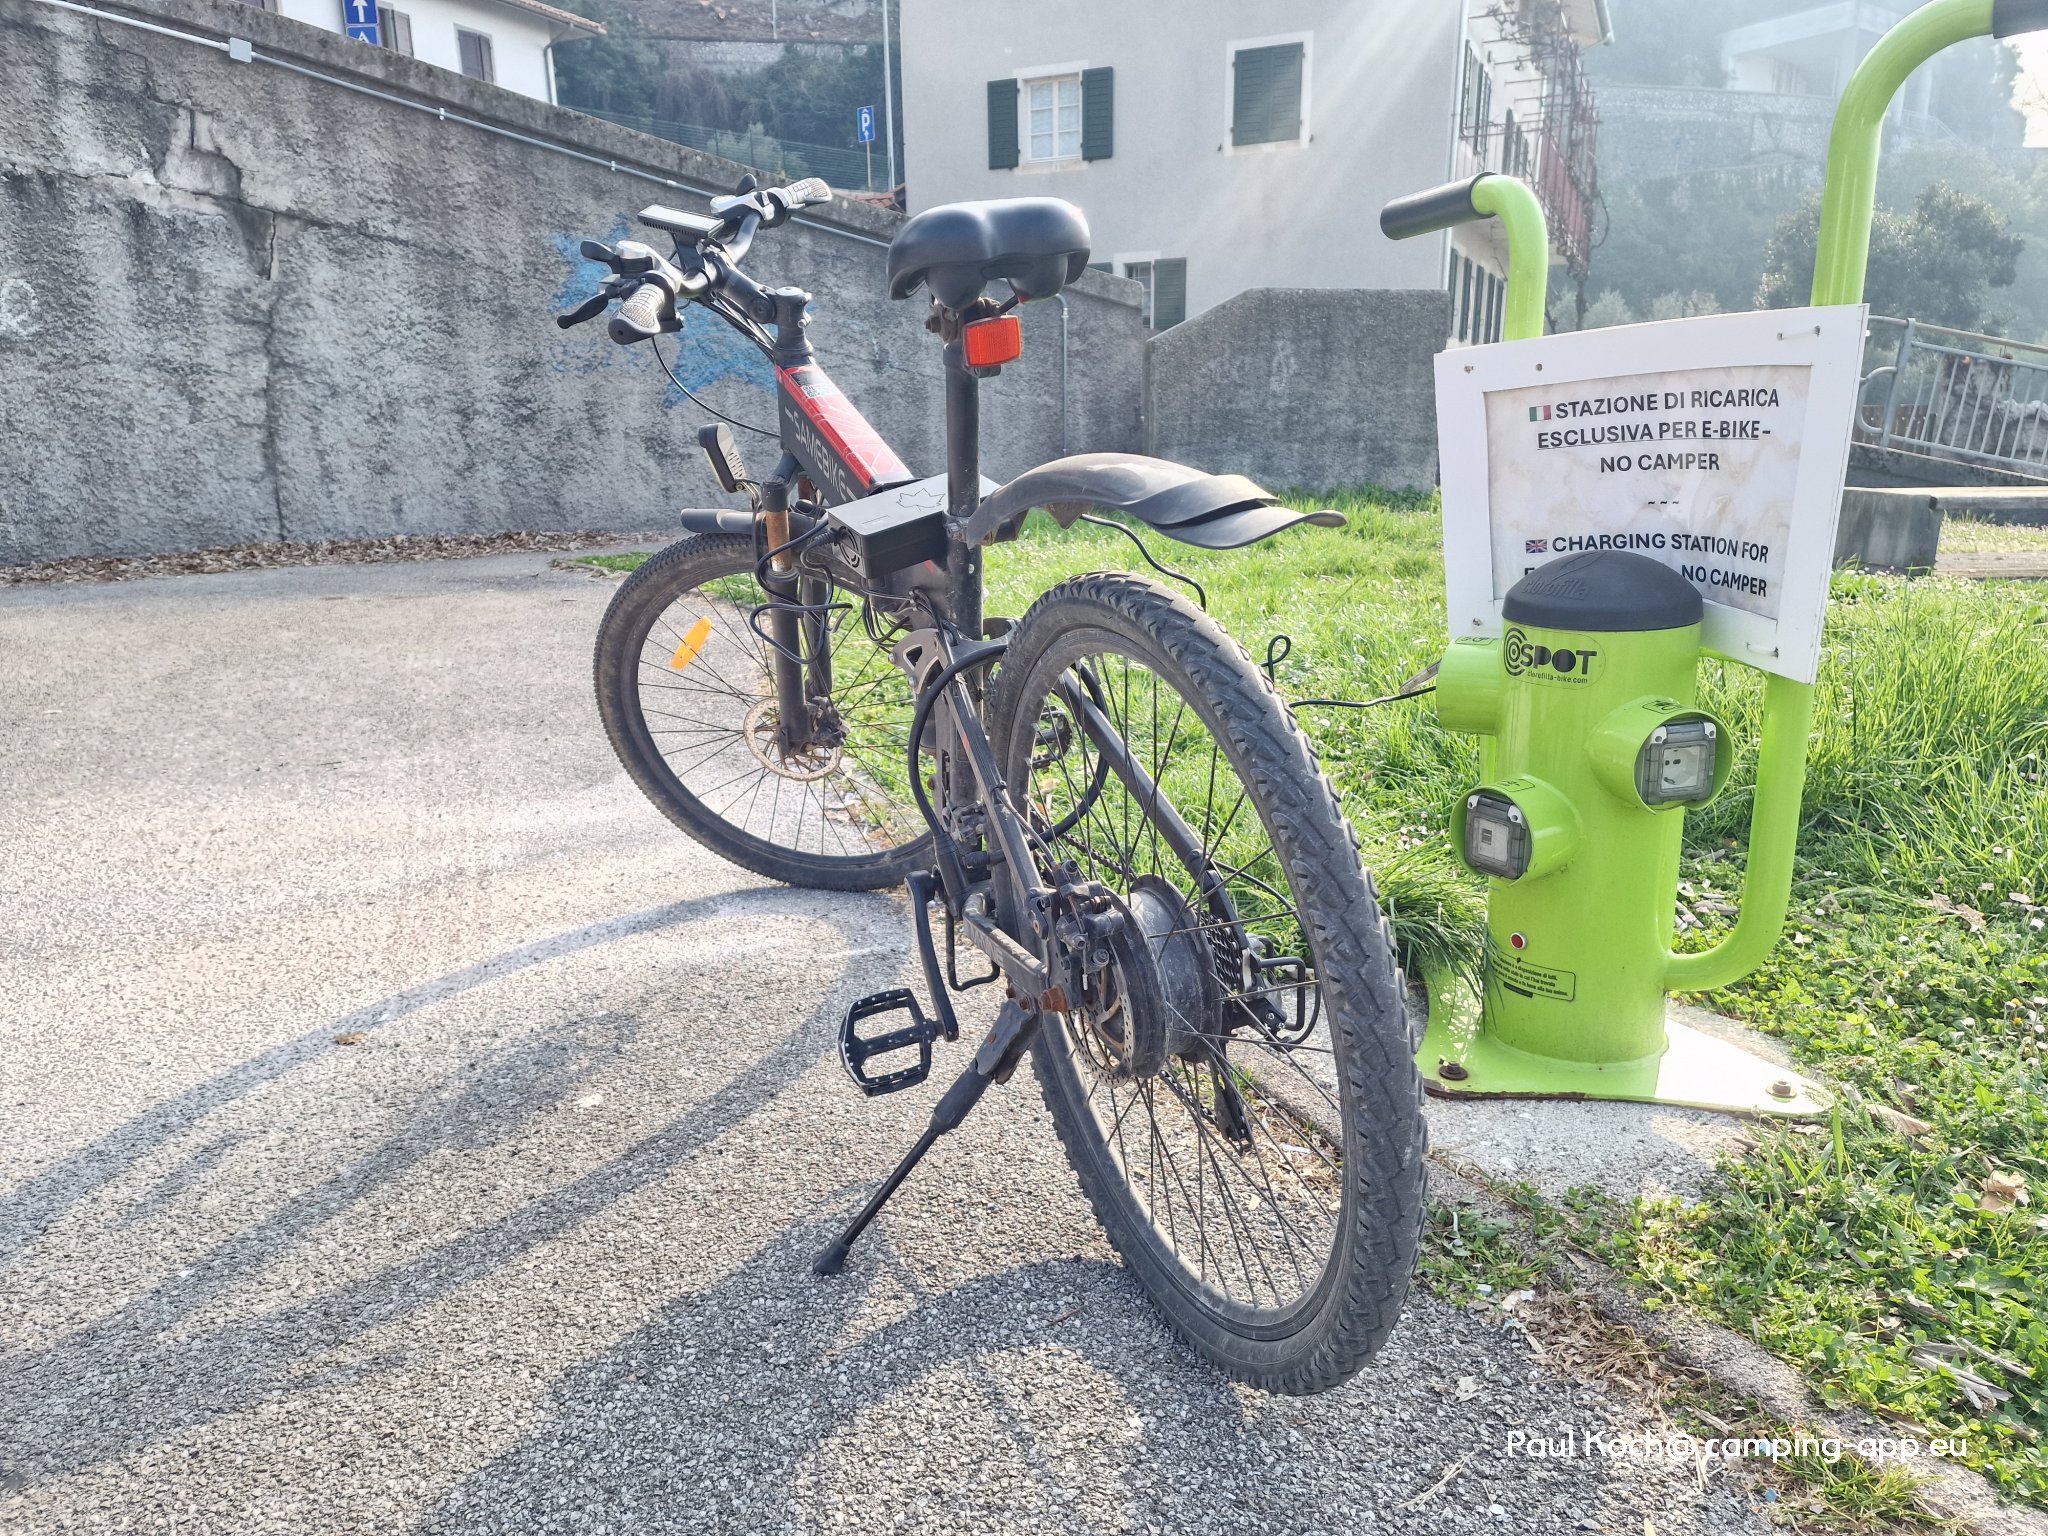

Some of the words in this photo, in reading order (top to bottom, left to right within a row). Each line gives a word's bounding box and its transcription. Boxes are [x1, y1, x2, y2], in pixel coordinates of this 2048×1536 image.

[861, 113, 871, 132] P
[1555, 393, 1658, 419] STAZIONE
[1664, 391, 1685, 410] DI
[1690, 388, 1780, 408] RICARICA
[1537, 422, 1654, 449] ESCLUSIVA
[1658, 420, 1697, 439] PER
[793, 410, 847, 502] SAMEBIKE
[1601, 455, 1632, 473] NO
[1638, 452, 1720, 472] CAMPER
[1551, 533, 1666, 552] CHARGING
[1670, 533, 1739, 557] STATION
[1741, 541, 1769, 564] FOR
[1681, 564, 1707, 583] NO
[1710, 568, 1767, 598] CAMPER
[1527, 670, 1588, 684] clorofilla-bike.com
